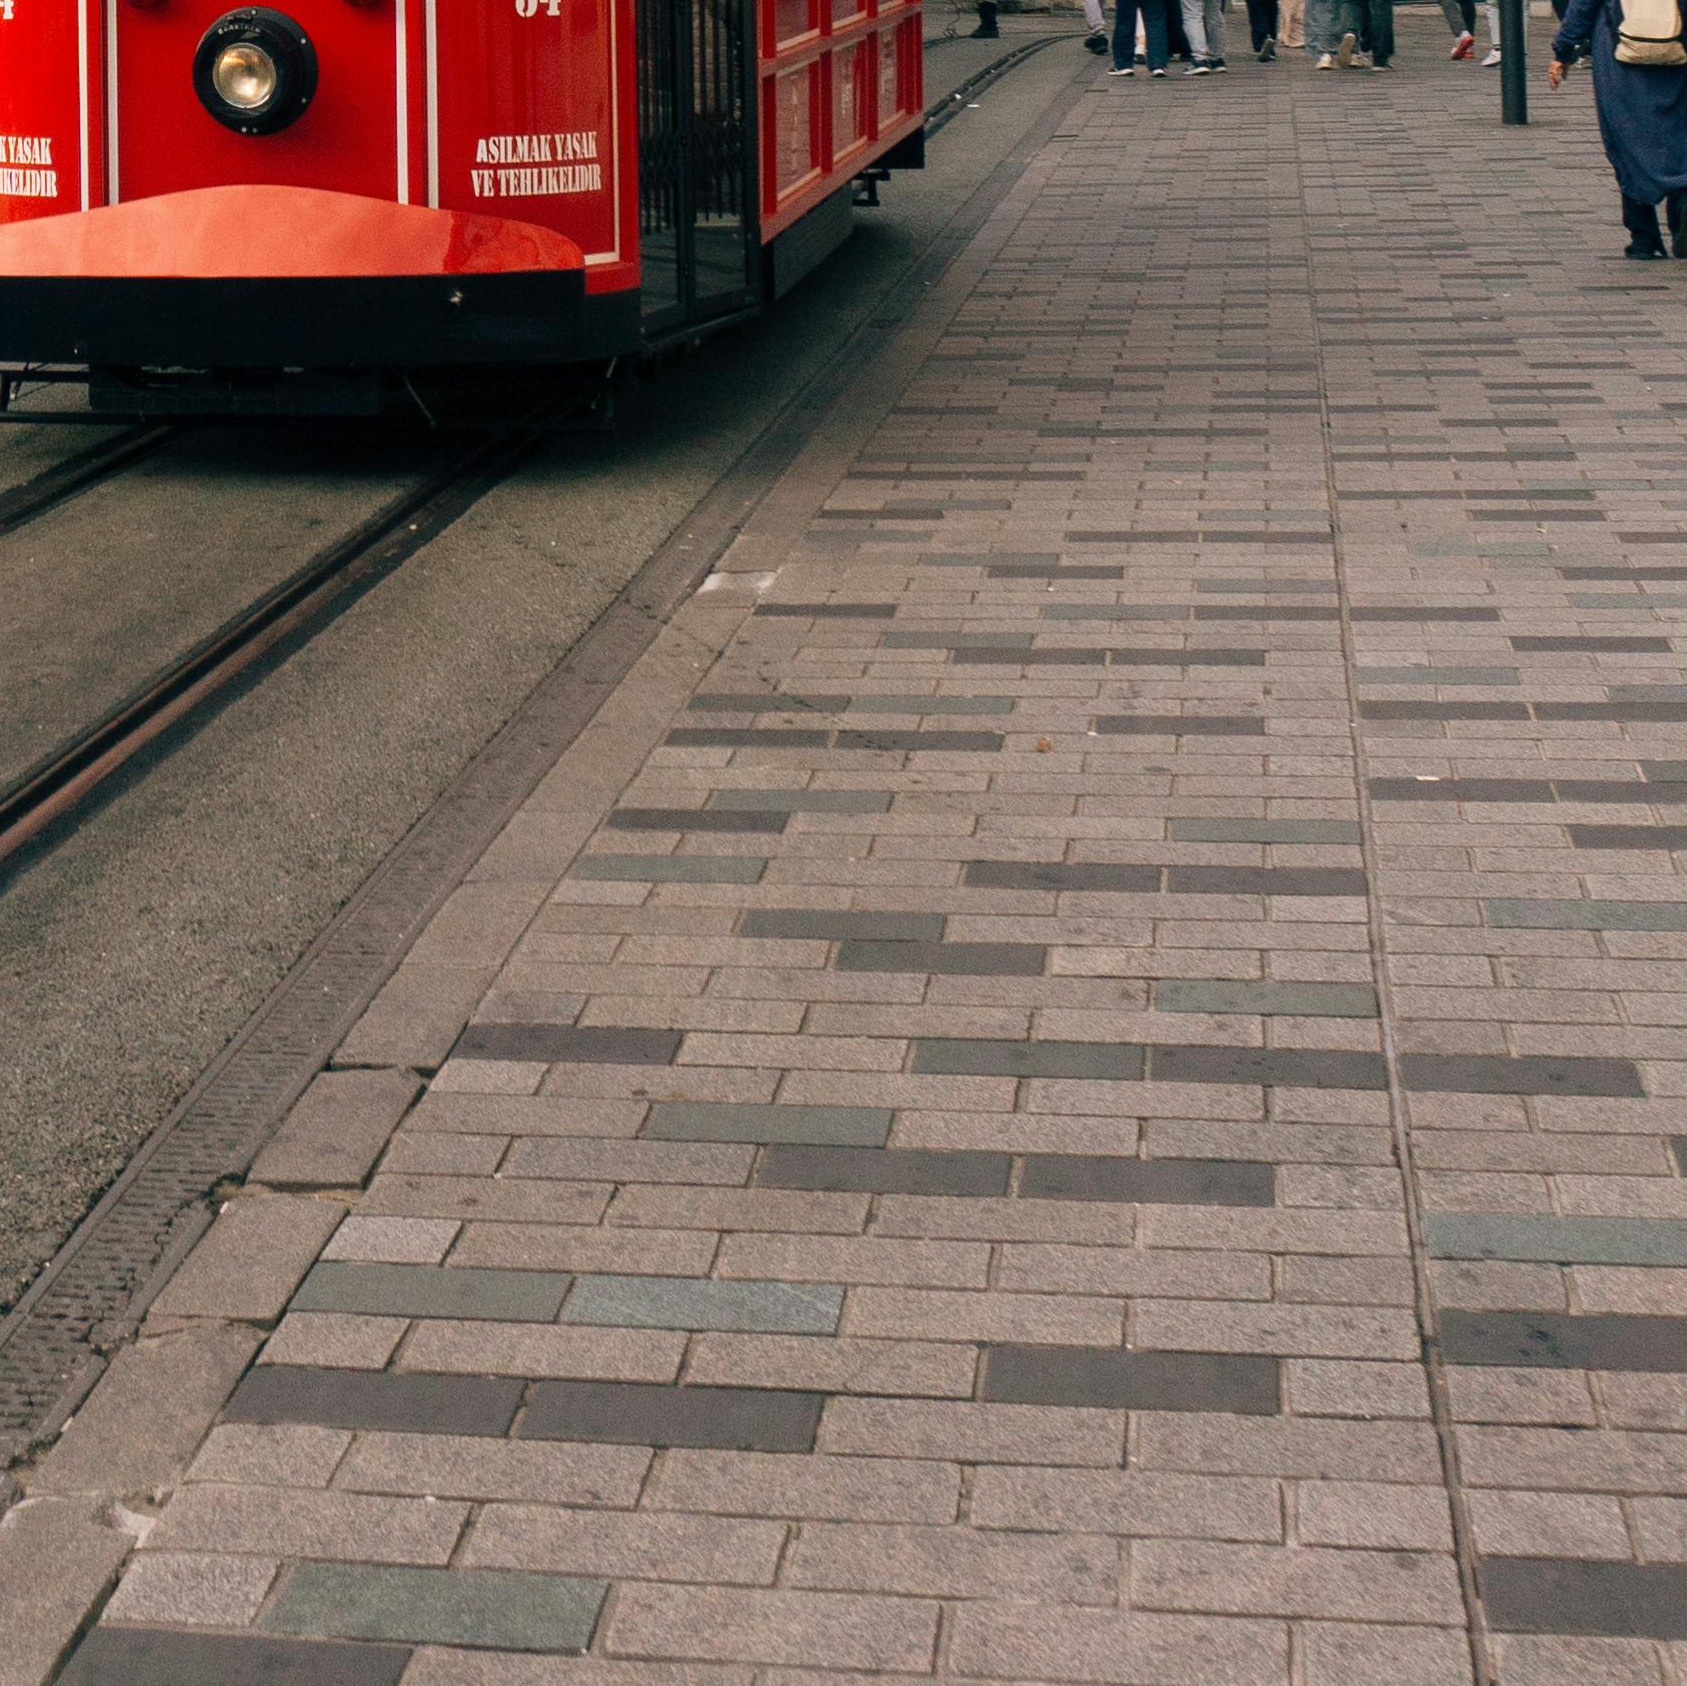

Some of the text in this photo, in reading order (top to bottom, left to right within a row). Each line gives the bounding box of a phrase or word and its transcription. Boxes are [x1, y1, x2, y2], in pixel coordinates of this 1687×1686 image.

[7, 136, 52, 165] YASAK
[476, 131, 598, 164] ASILMAK YASAK
[471, 164, 602, 198] VE TEHLIKELIDIR
